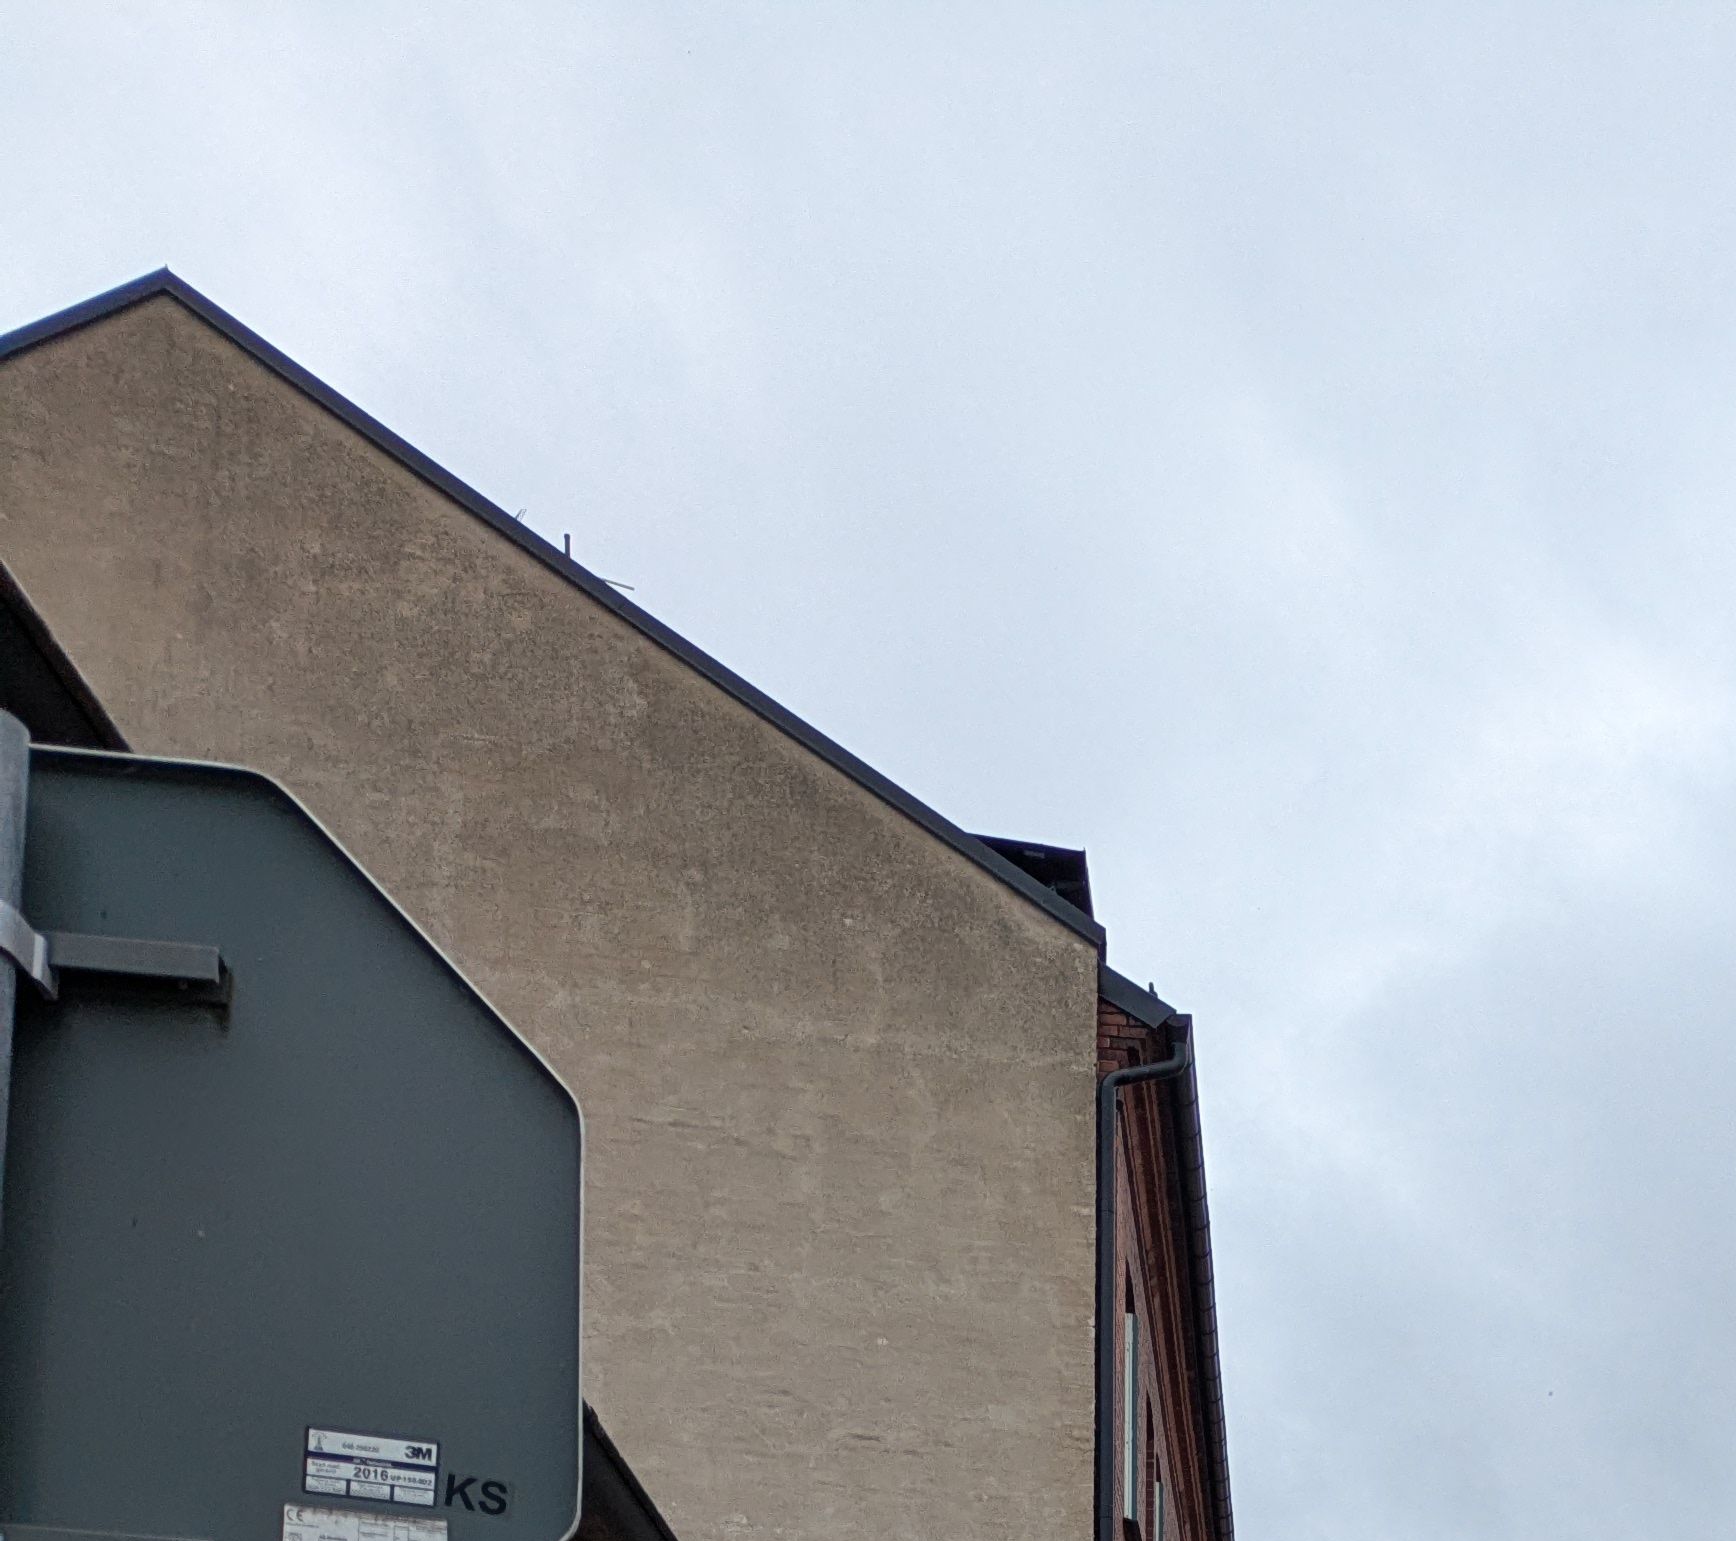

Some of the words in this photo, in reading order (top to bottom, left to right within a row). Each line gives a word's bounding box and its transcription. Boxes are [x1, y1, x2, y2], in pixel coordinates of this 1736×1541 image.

[404, 1445, 433, 1462] 3M
[353, 1466, 388, 1483] 2016
[444, 1472, 508, 1516] KS
[286, 1508, 305, 1523] CE
